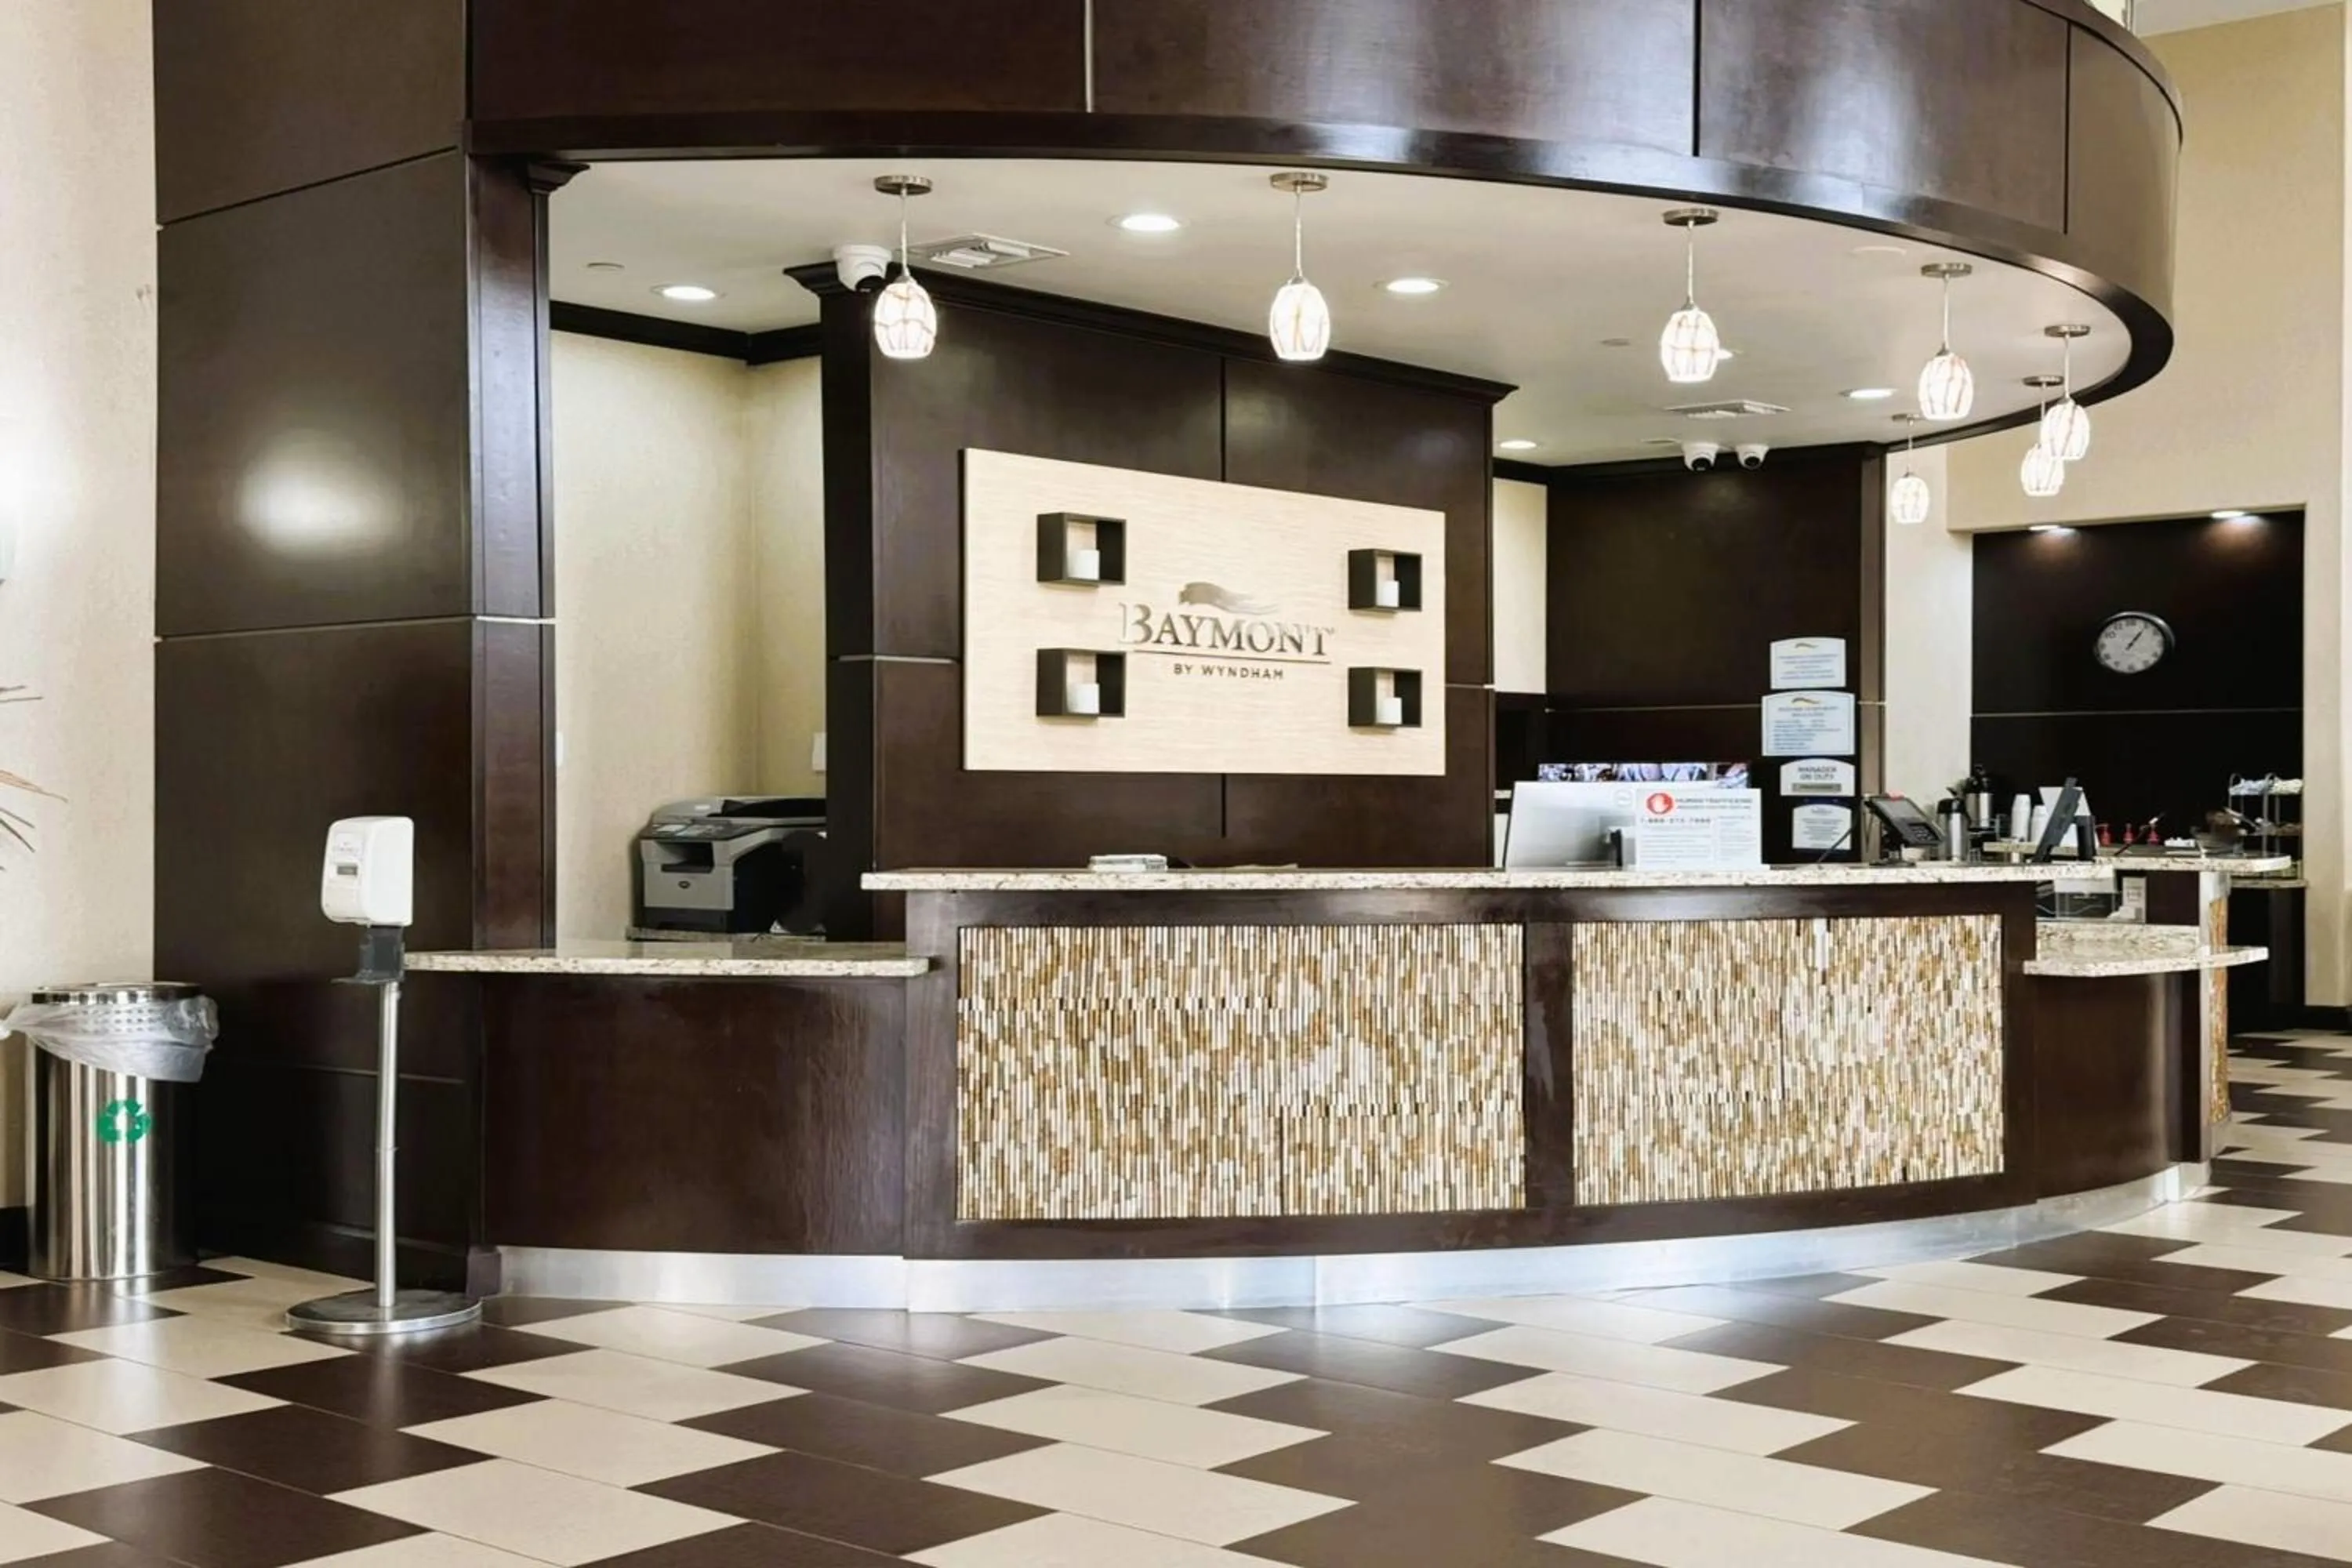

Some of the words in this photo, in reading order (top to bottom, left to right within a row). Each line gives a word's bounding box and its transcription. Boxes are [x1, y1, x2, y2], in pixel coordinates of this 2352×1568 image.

[1119, 602, 1333, 655] BAYMONT
[1174, 664, 1192, 674] BY
[1202, 666, 1283, 679] WYNDHAM
